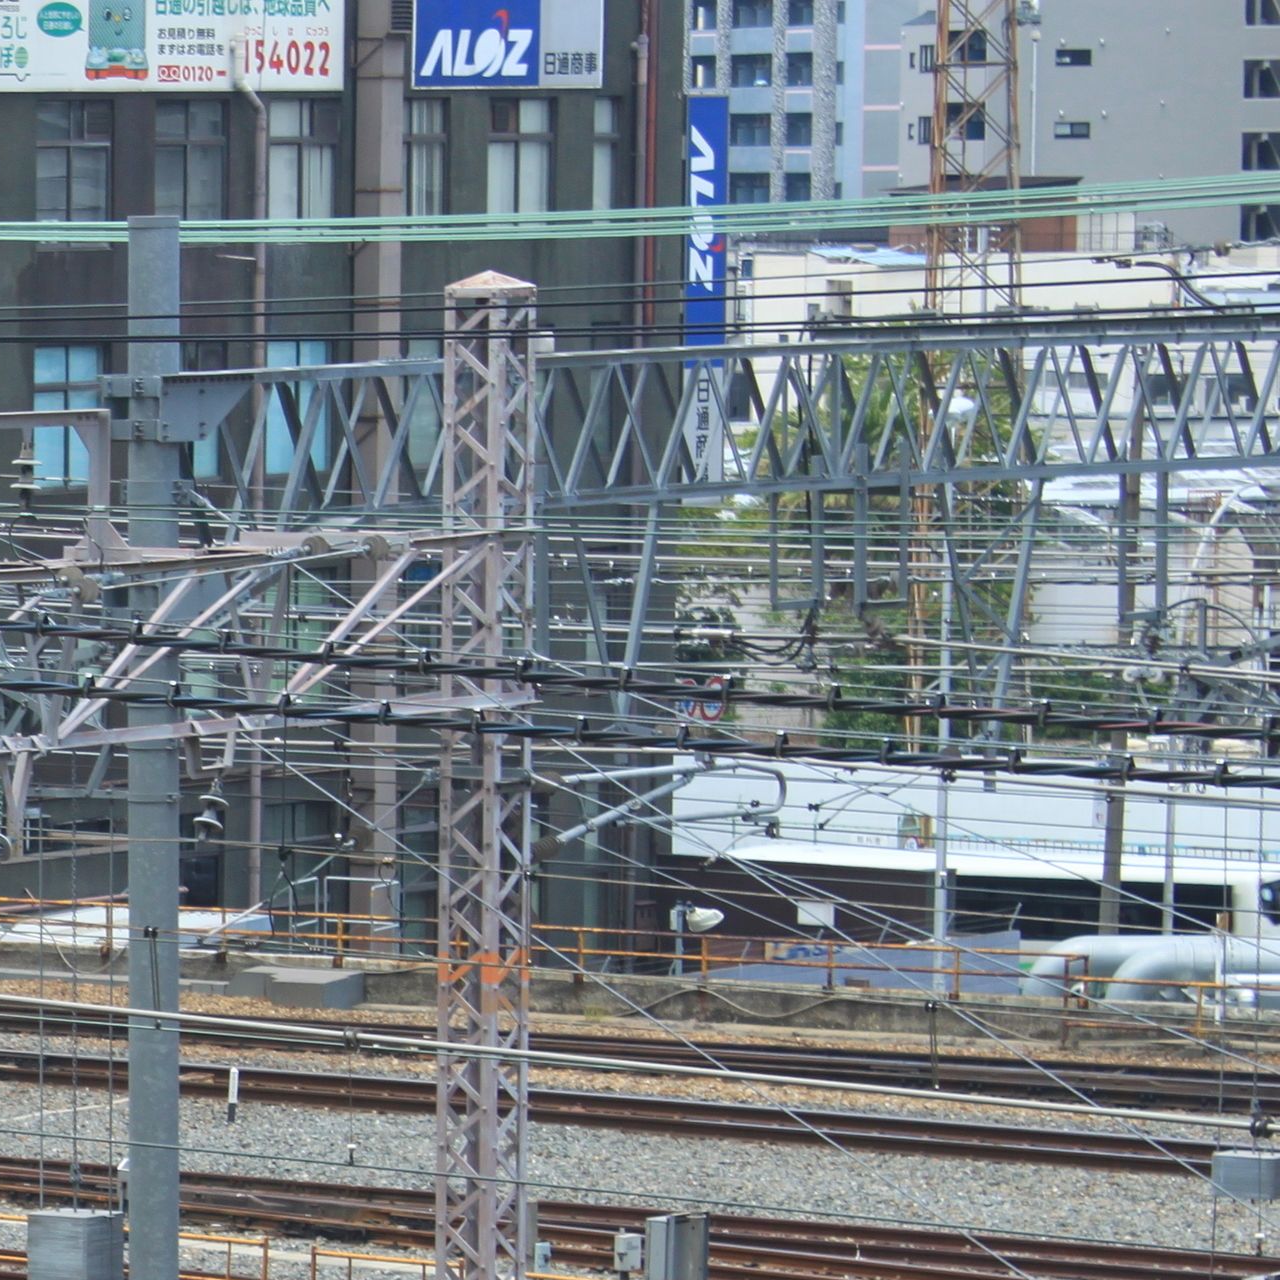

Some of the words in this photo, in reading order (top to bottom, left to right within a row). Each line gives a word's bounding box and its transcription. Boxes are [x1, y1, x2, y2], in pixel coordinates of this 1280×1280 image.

[157, 28, 216, 39] お見積り無料
[157, 43, 225, 56] まずはお電話を
[419, 28, 534, 77] ALOZ
[544, 52, 598, 75] 日通商事
